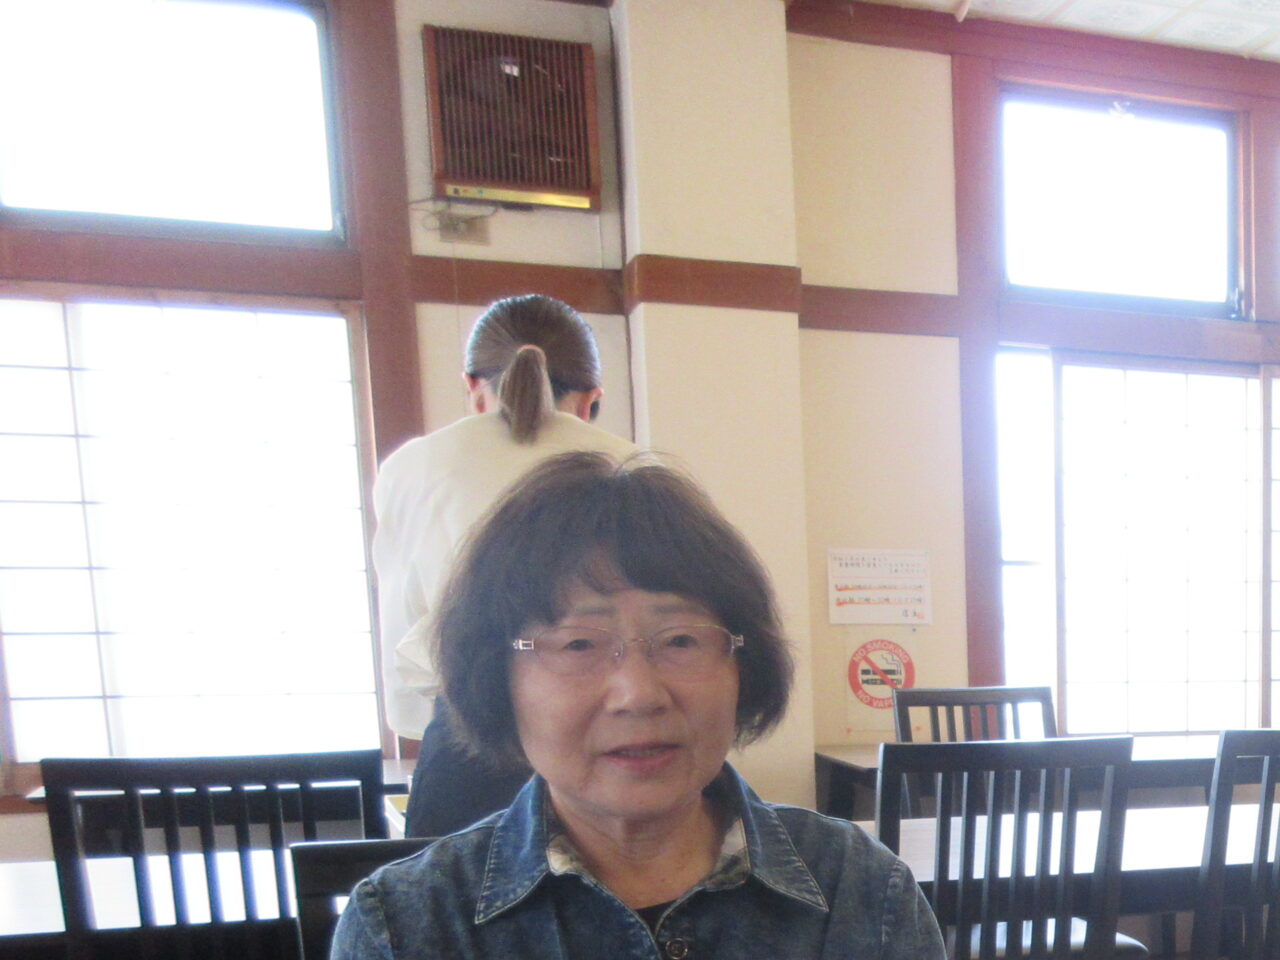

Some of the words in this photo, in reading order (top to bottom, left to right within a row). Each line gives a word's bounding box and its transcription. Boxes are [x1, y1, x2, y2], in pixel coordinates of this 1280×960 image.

[853, 648, 866, 660] NO
[864, 640, 908, 663] SMOKING
[856, 690, 870, 703] NO
